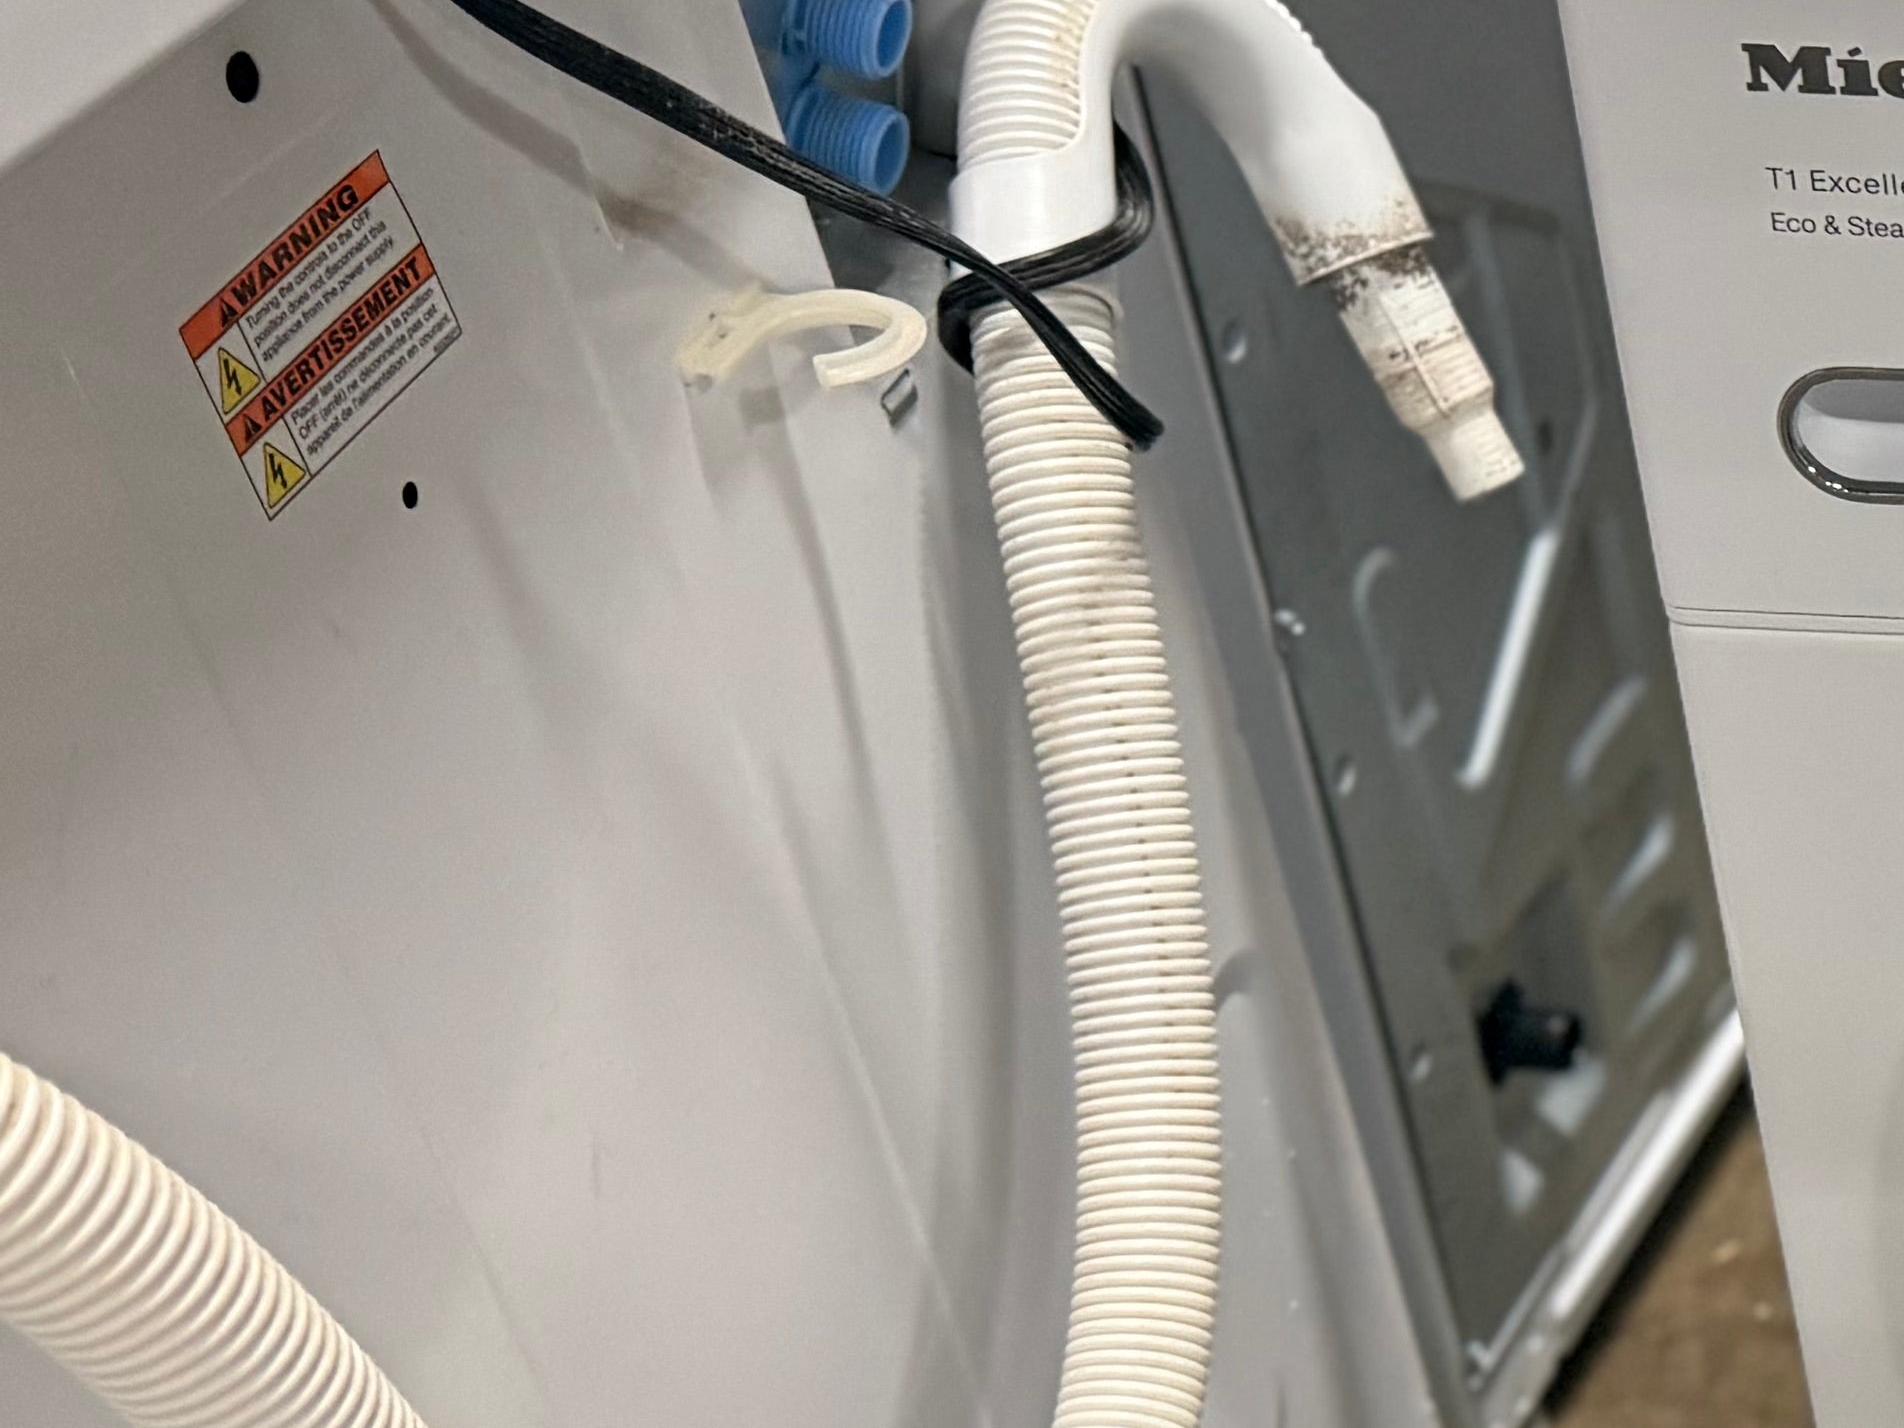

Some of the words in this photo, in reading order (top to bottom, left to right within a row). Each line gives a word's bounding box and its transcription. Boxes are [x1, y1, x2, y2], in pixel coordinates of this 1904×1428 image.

[1764, 167, 1797, 191] T1
[230, 184, 358, 306] WARNING
[1770, 212, 1816, 234] Eco
[1824, 215, 1842, 235] &
[261, 251, 420, 422] AVERTISSEMENT
